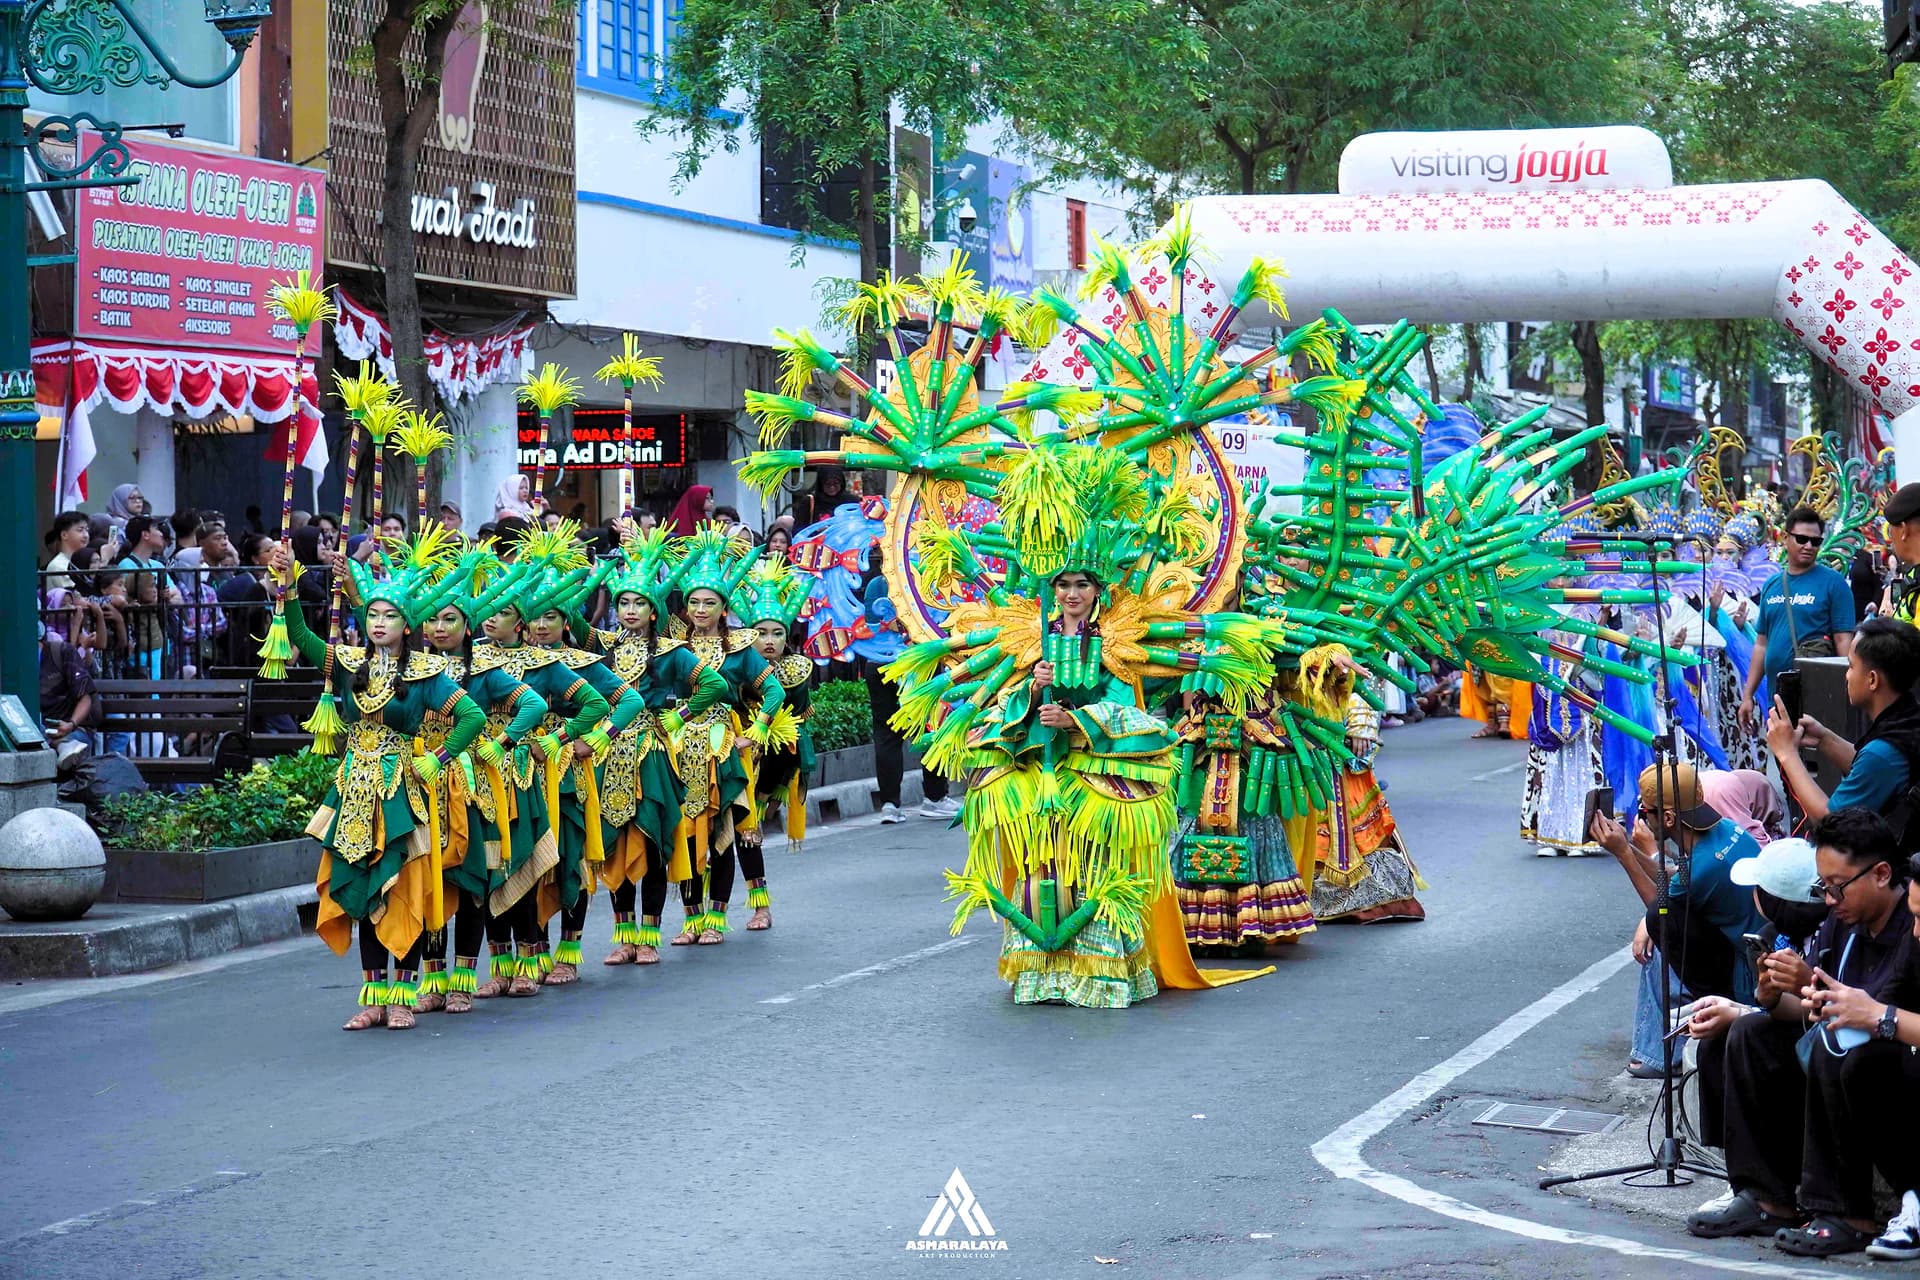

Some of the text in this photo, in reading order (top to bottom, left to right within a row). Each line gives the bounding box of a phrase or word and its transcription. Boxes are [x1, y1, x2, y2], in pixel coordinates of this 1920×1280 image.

[1390, 140, 1610, 184] visiting jogja
[191, 168, 293, 226] OLEH-OLEH
[410, 182, 537, 249] nar Hadi
[92, 218, 313, 271] PUSATNYA OLEH-OLEH KHAS JOGJA
[99, 267, 170, 289] KAOS SABLON
[185, 277, 213, 293] KAOS
[213, 279, 251, 297] SINGLET
[99, 287, 170, 310] KAOS BORDIR
[185, 296, 226, 314] SETELAN
[228, 300, 256, 317] ANAK
[99, 309, 132, 327] BATIK
[185, 318, 231, 335] AKSESORIS
[272, 323, 298, 341] SURJA
[1222, 432, 1245, 450] 09
[563, 441, 594, 464] Ad
[1234, 464, 1268, 479] ARNA
[1020, 553, 1065, 576] WARNA
